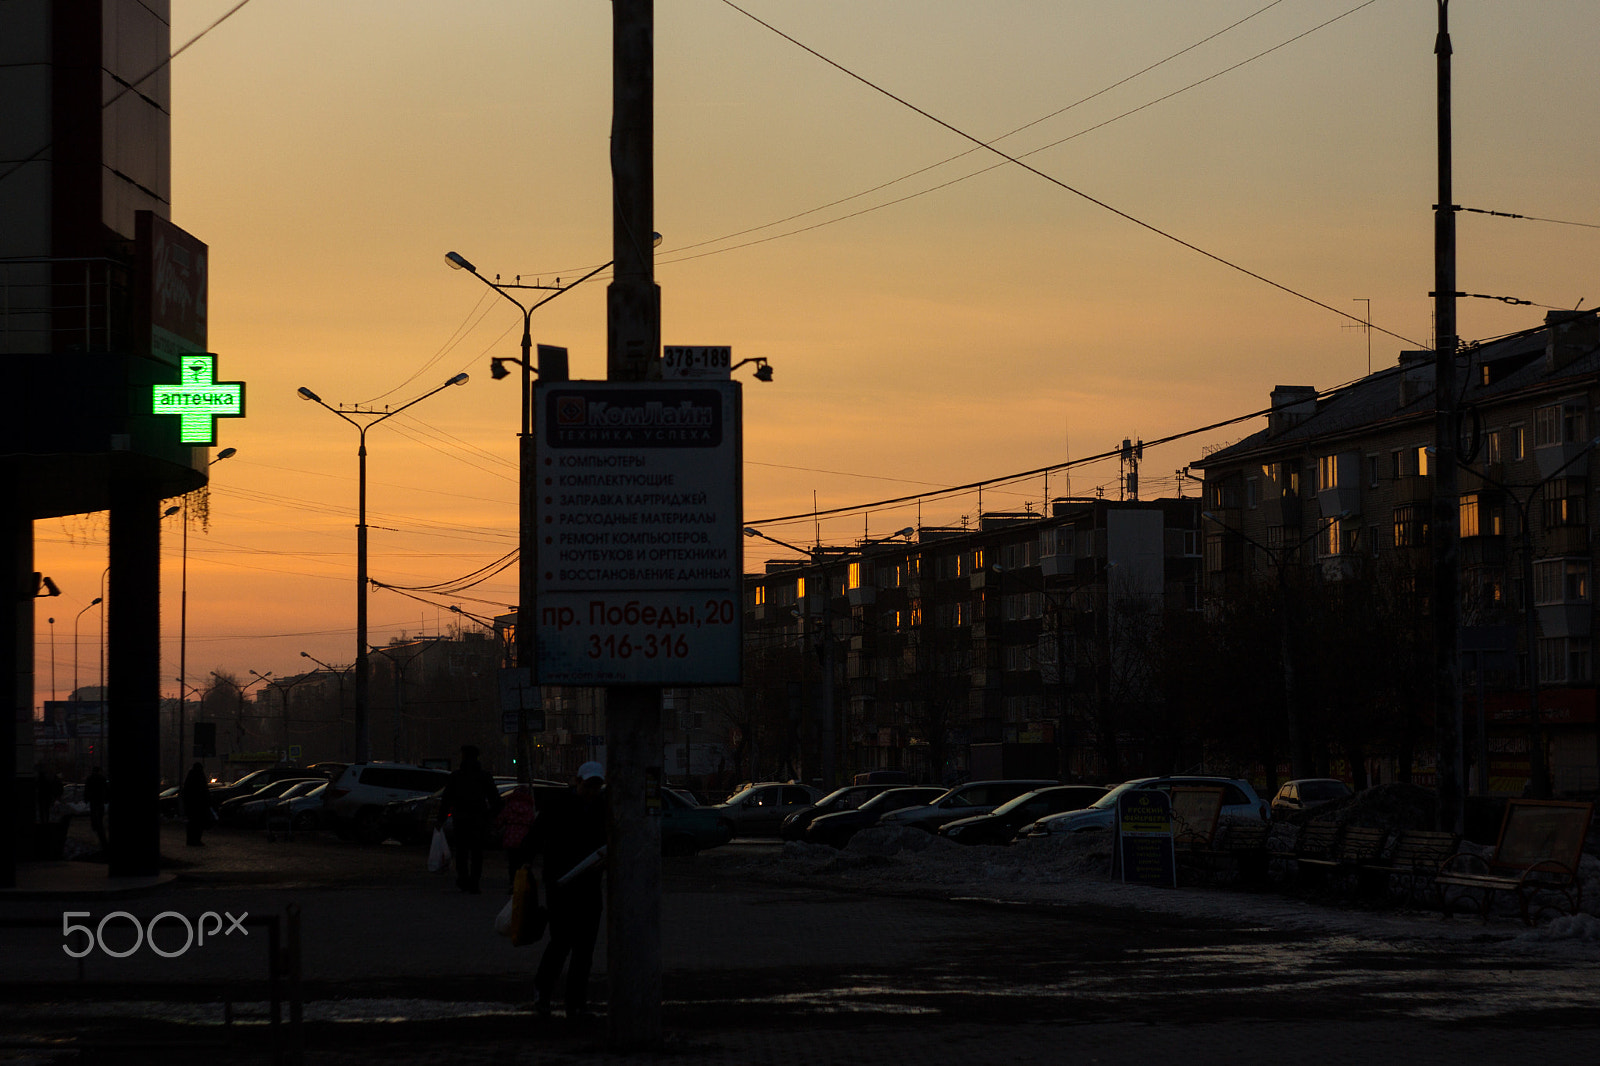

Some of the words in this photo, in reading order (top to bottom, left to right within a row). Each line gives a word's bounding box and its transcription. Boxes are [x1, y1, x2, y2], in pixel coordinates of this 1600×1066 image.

[666, 349, 729, 368] 378-189
[160, 393, 235, 405] аптечка
[587, 400, 713, 425] КомЛайн
[559, 430, 634, 441] ТЕХНИКА
[644, 430, 712, 441] УСПЕХА
[559, 456, 646, 467] КОМПЬЮТЕРЫ
[559, 475, 674, 487] КОМПЛЕКТУЮЩИЕ
[560, 494, 624, 505] ЗАПРАВКА
[626, 492, 707, 506] КАРТРИДЖЕЙ
[559, 513, 638, 525] РАСХОДНЫЕ
[641, 513, 716, 524] МАТЕРИАЛЫ
[559, 532, 610, 544] РЕМОНТ
[613, 532, 712, 544] КОМПЬЮТЕРОВ,
[560, 549, 634, 560] НОУТБУКОВ
[637, 550, 646, 560] И
[649, 549, 727, 560] ОРГТЕХНИКИ
[559, 568, 675, 580] ВОССТАНОВЛЕНИЕ
[677, 568, 731, 580] ДАННЫХ
[542, 606, 581, 631] пр.
[588, 634, 689, 659] 316-316
[547, 671, 626, 680] www.comline.ru
